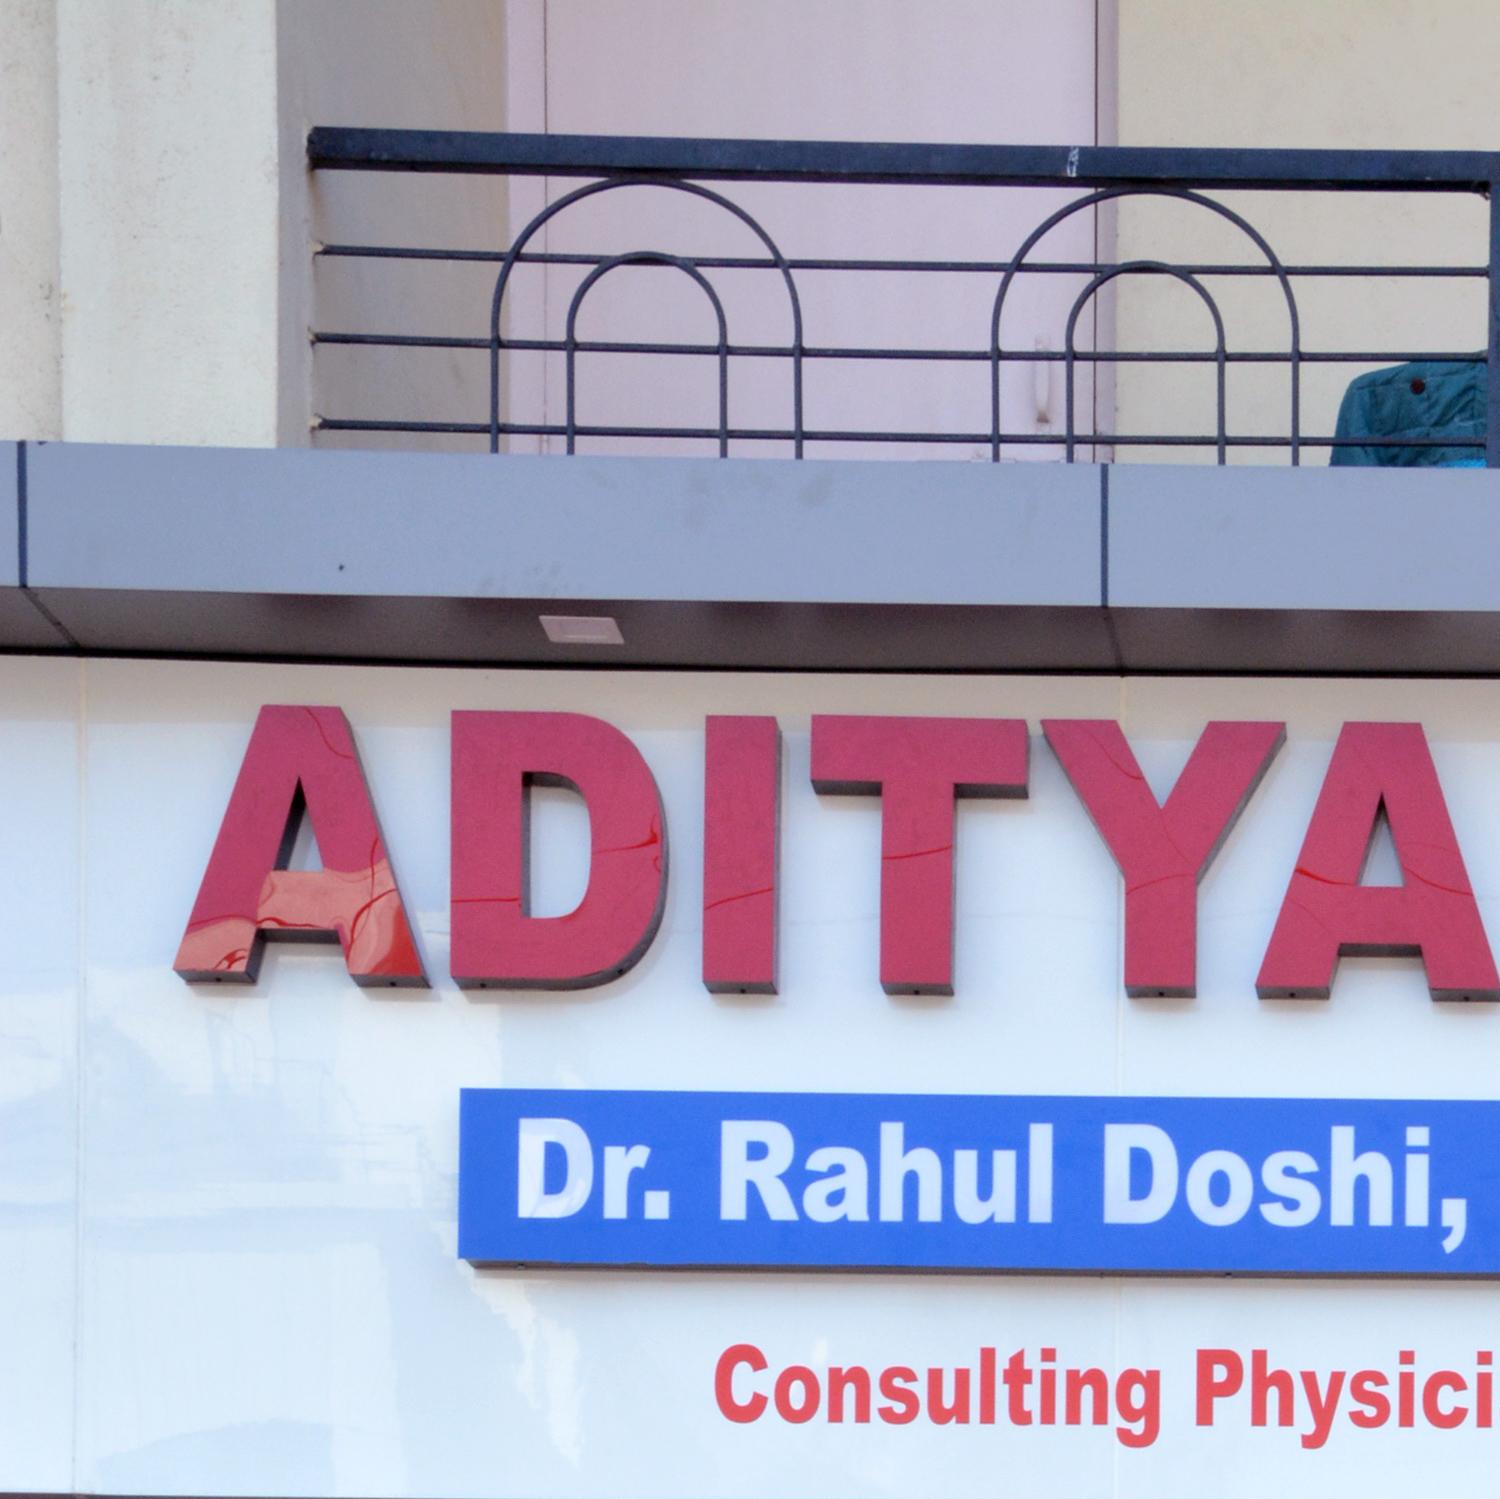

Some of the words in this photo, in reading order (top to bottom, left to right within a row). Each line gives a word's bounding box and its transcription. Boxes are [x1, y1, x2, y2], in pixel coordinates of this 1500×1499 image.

[517, 1117, 671, 1219] Dr.
[719, 1119, 1053, 1224] Rahul
[1102, 1122, 1468, 1254] Doshi,
[714, 1342, 1161, 1447] Consulting
